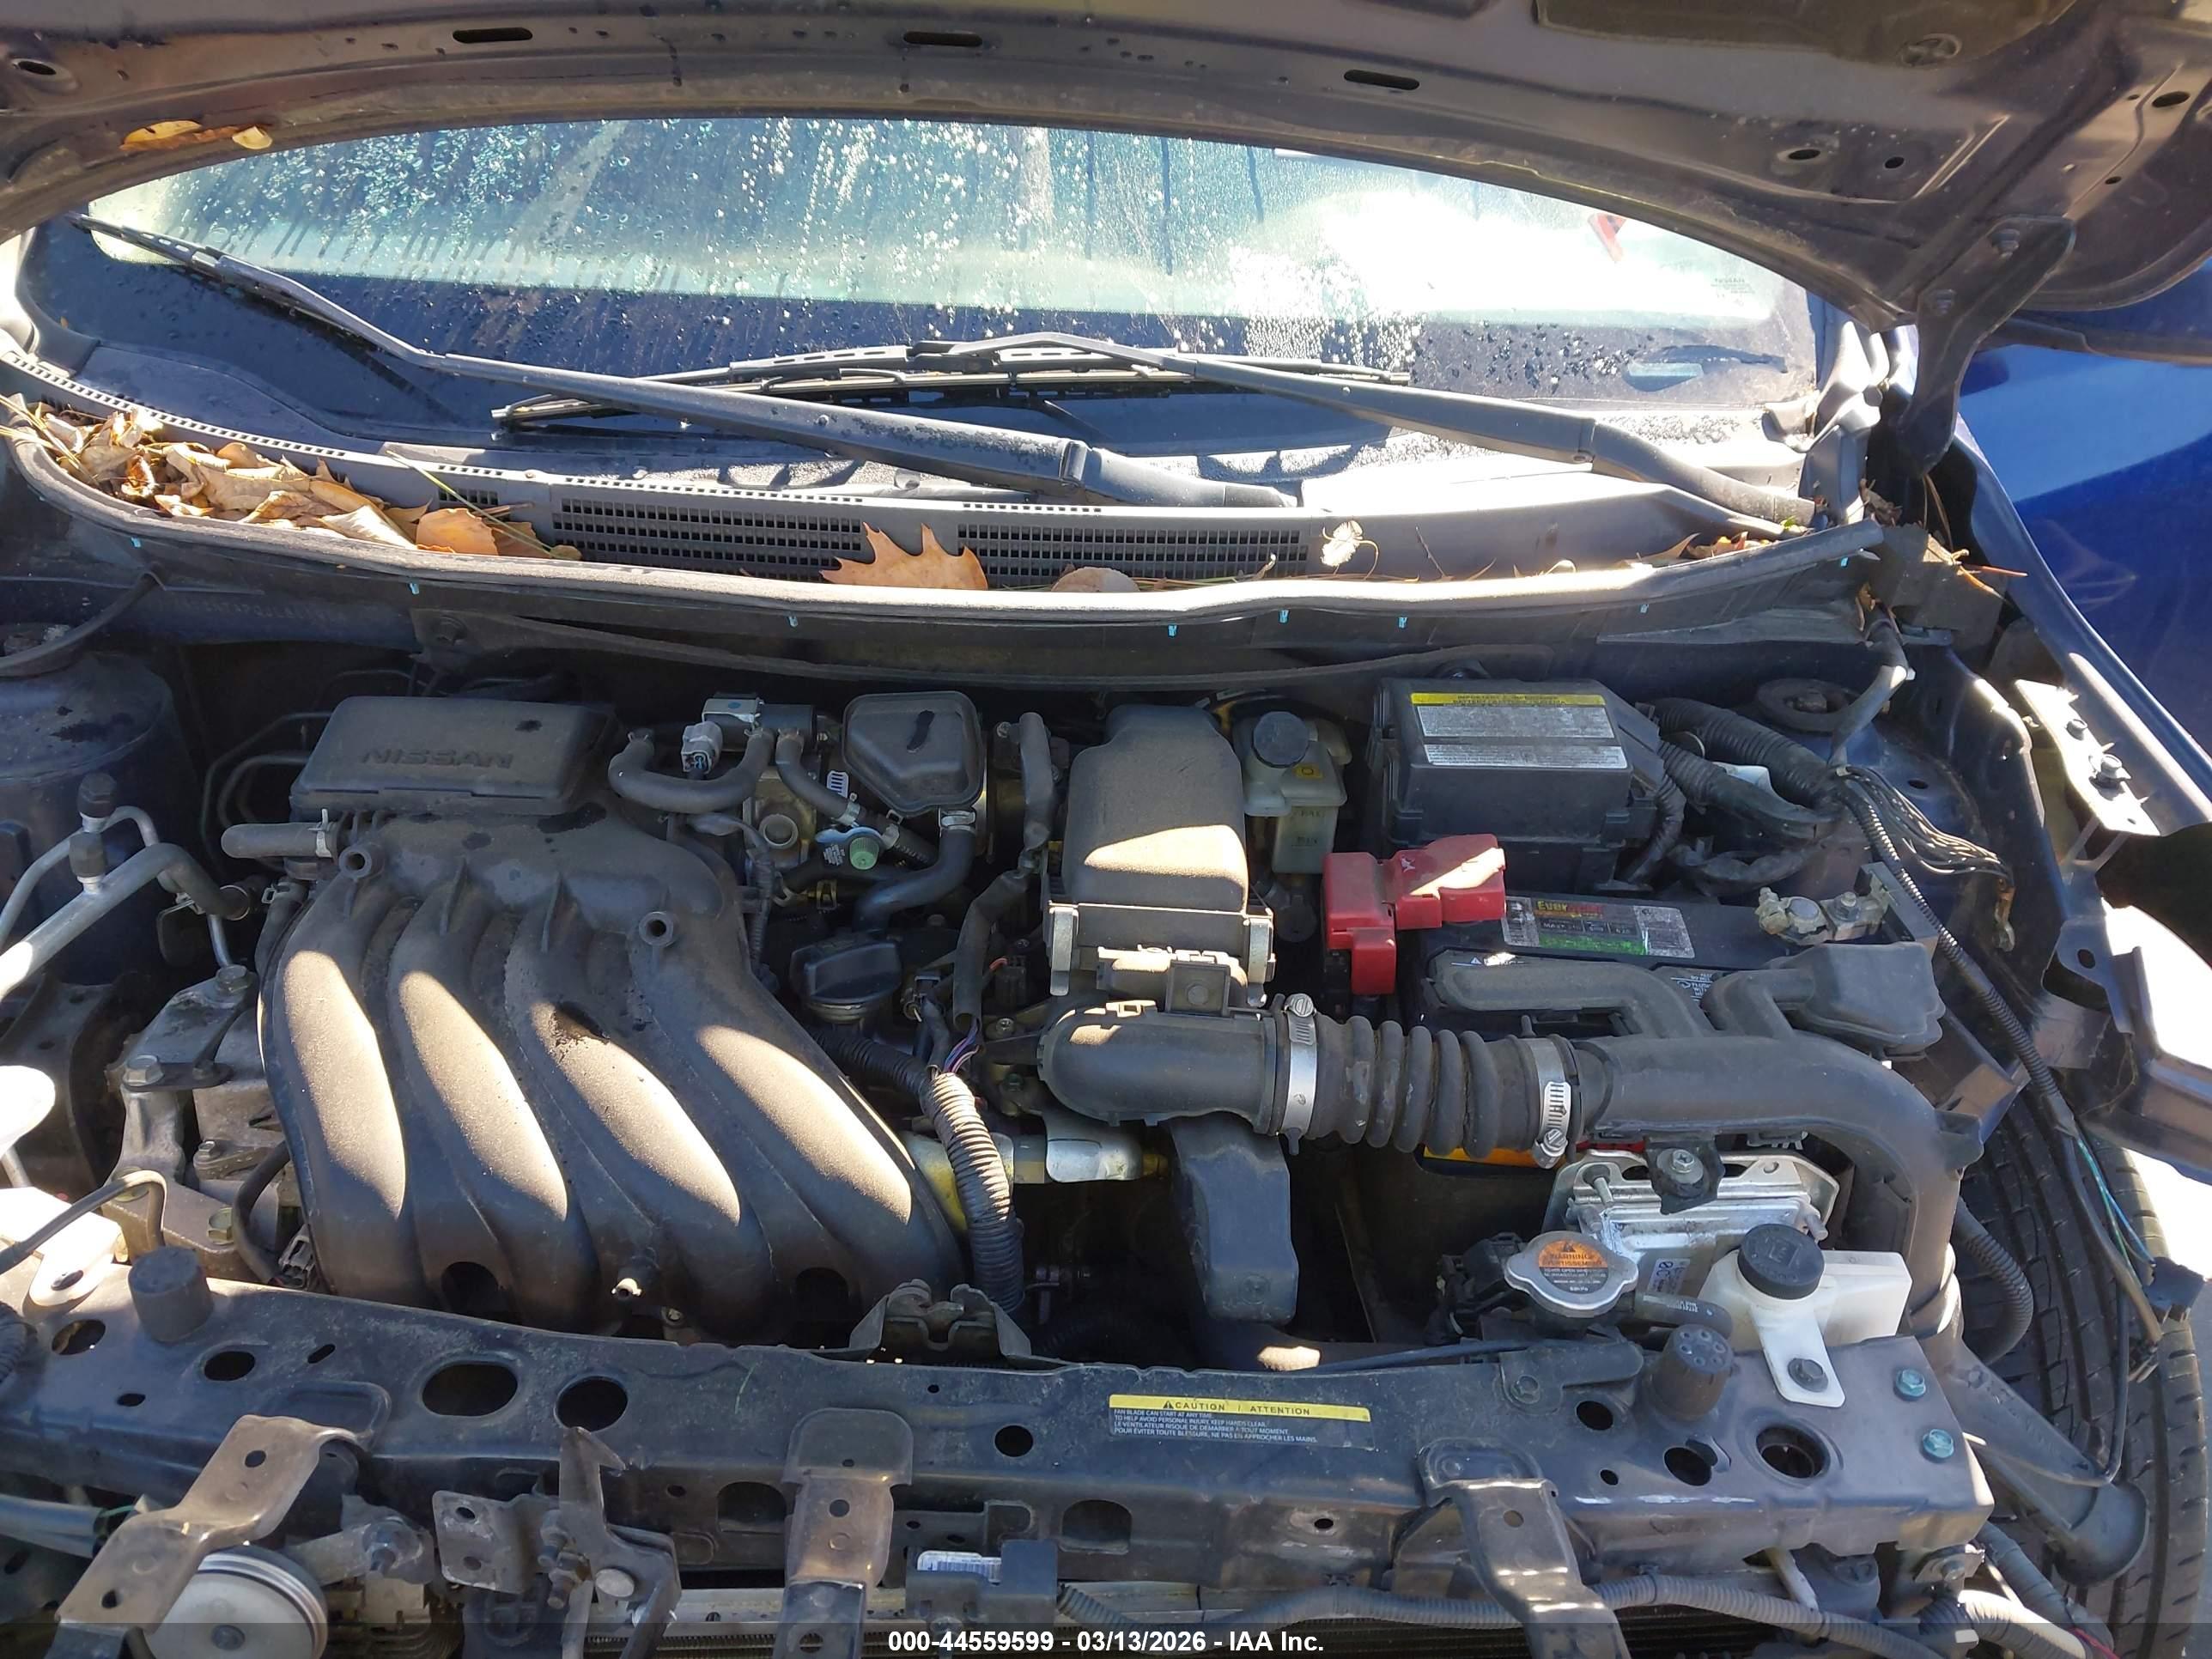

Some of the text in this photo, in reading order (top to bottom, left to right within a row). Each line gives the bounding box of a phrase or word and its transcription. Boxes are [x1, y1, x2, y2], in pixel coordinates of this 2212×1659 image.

[360, 748, 514, 769] NISSAN
[1176, 1401, 1225, 1411] CAUTION
[1250, 1406, 1310, 1415] ATTENTION
